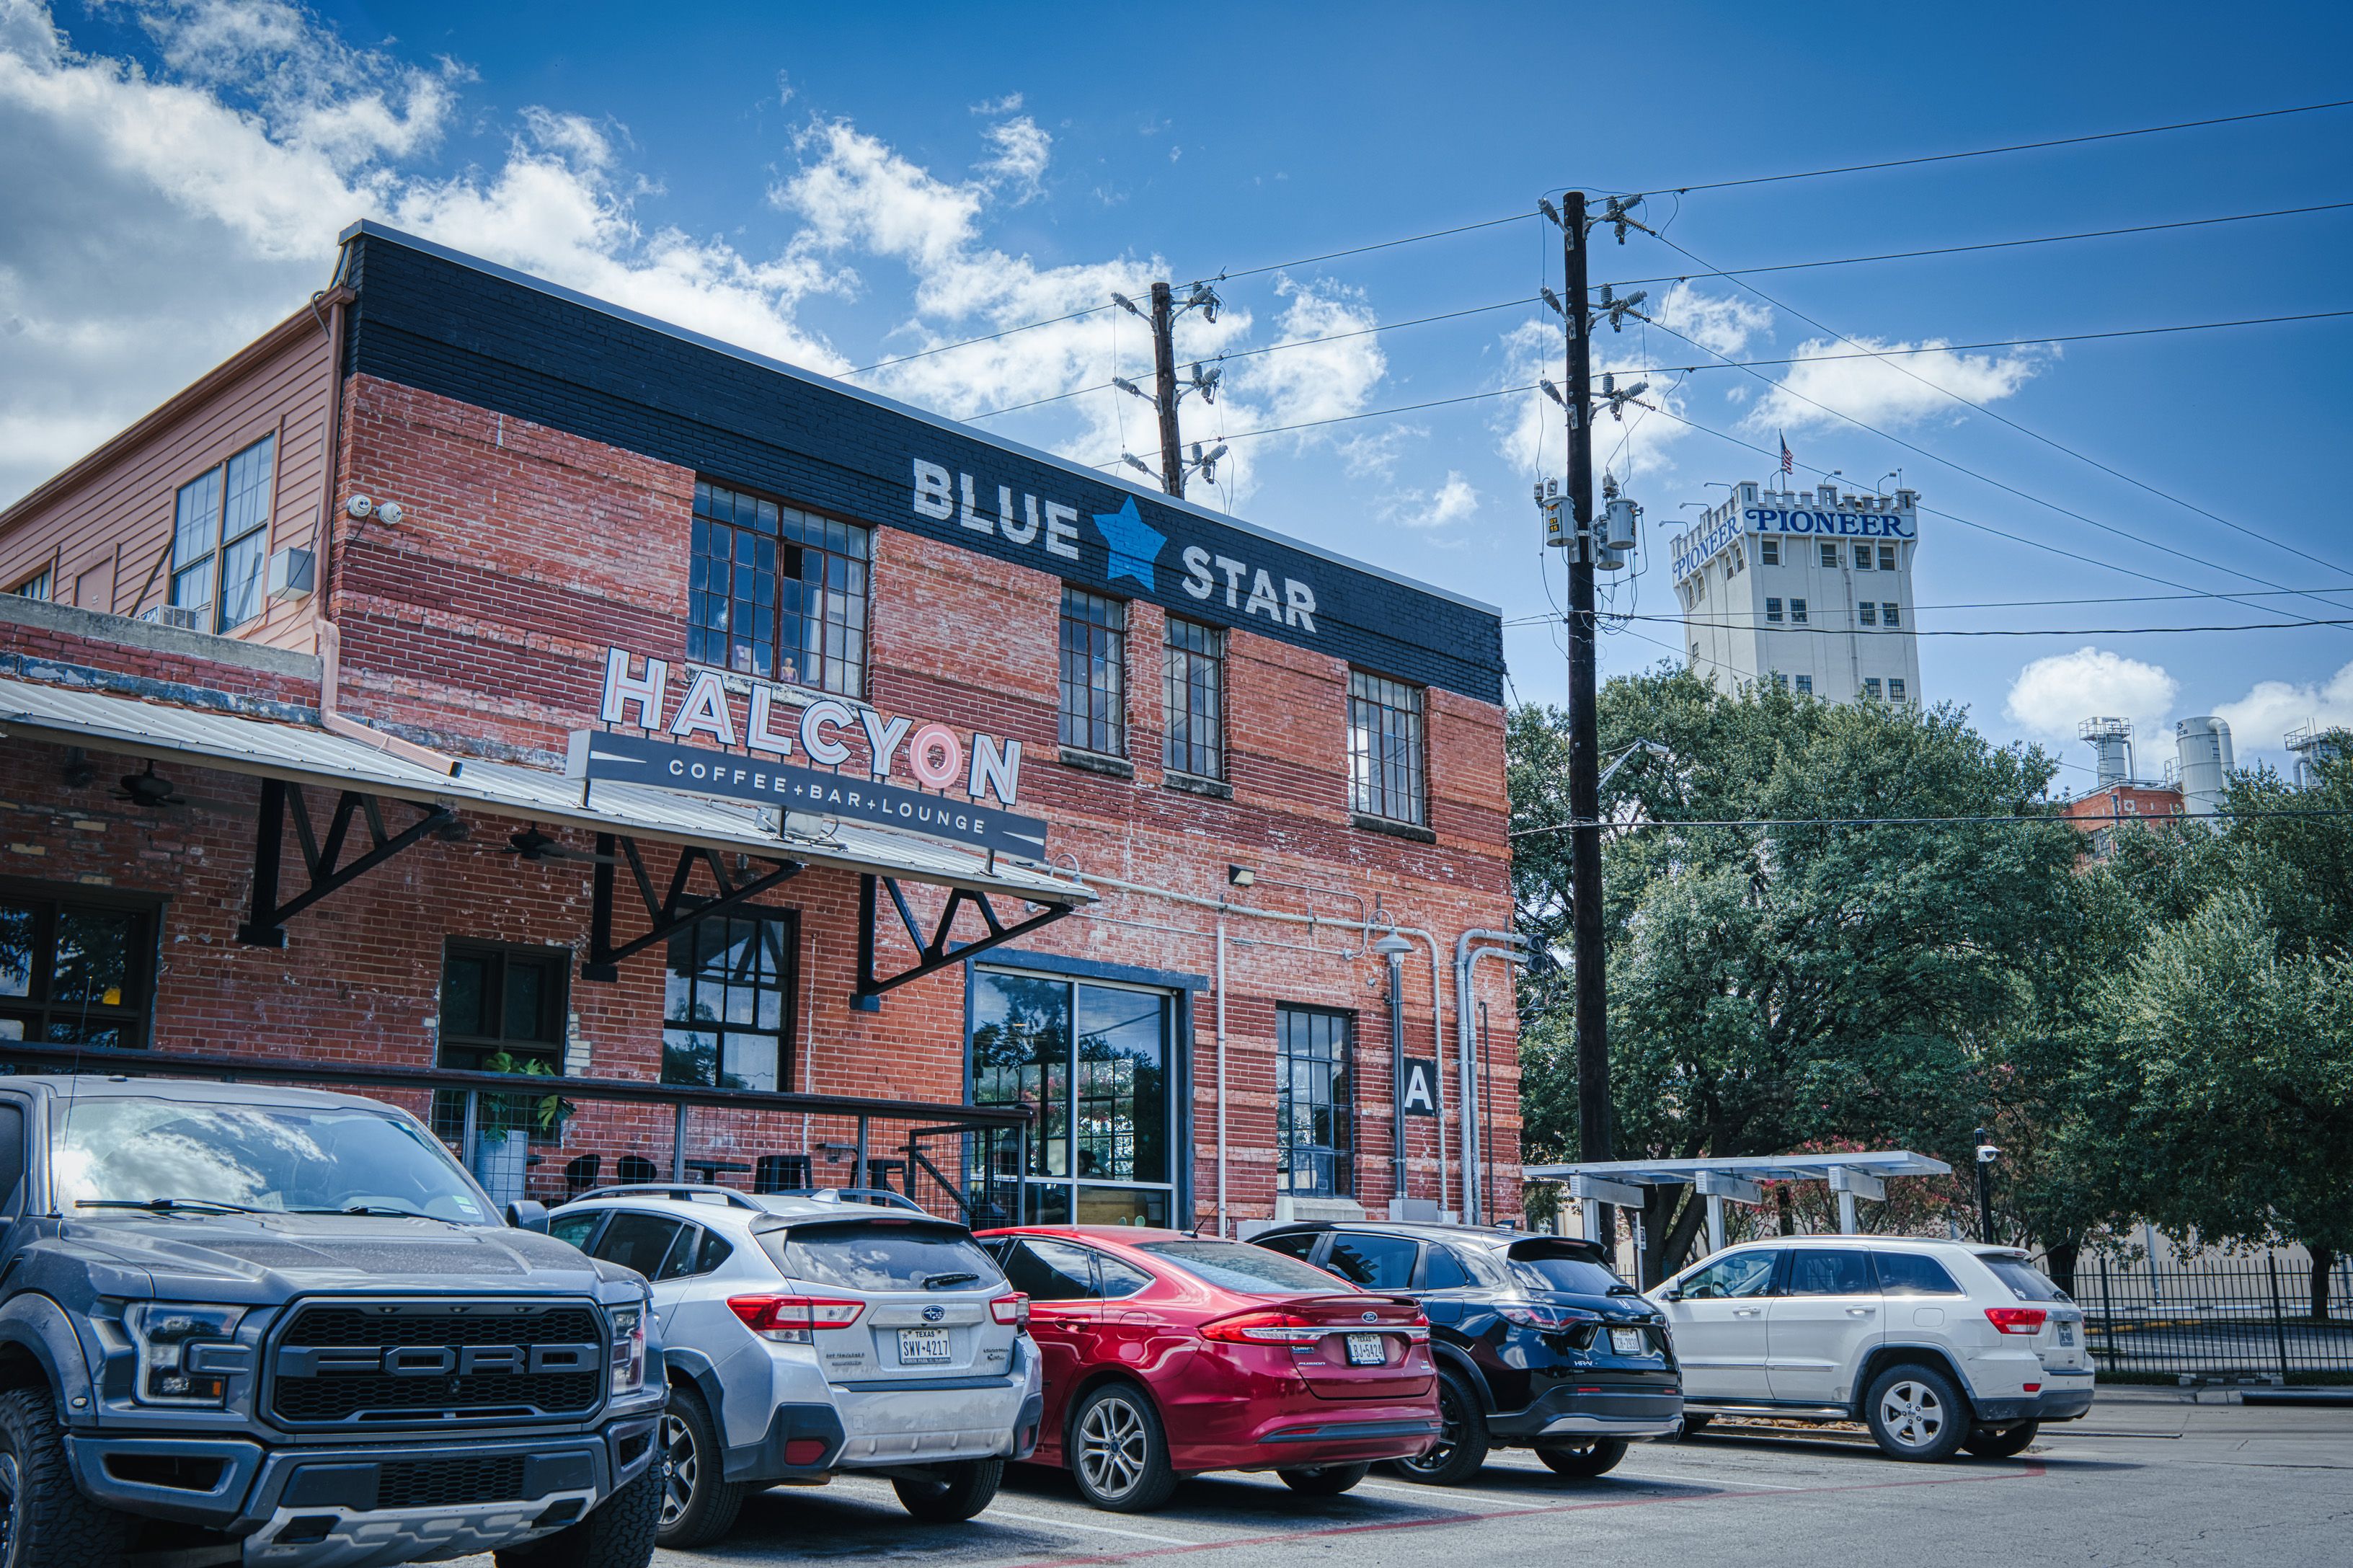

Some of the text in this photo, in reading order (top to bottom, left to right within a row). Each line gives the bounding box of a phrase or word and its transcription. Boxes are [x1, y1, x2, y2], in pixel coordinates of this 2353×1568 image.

[913, 458, 1316, 633] BLUE STAR
[1673, 515, 1743, 580] PIONEER
[1745, 509, 1914, 537] PIONEER
[600, 646, 1022, 806] HALCYON
[1405, 1066, 1433, 1110] A
[276, 1344, 601, 1378] FORD
